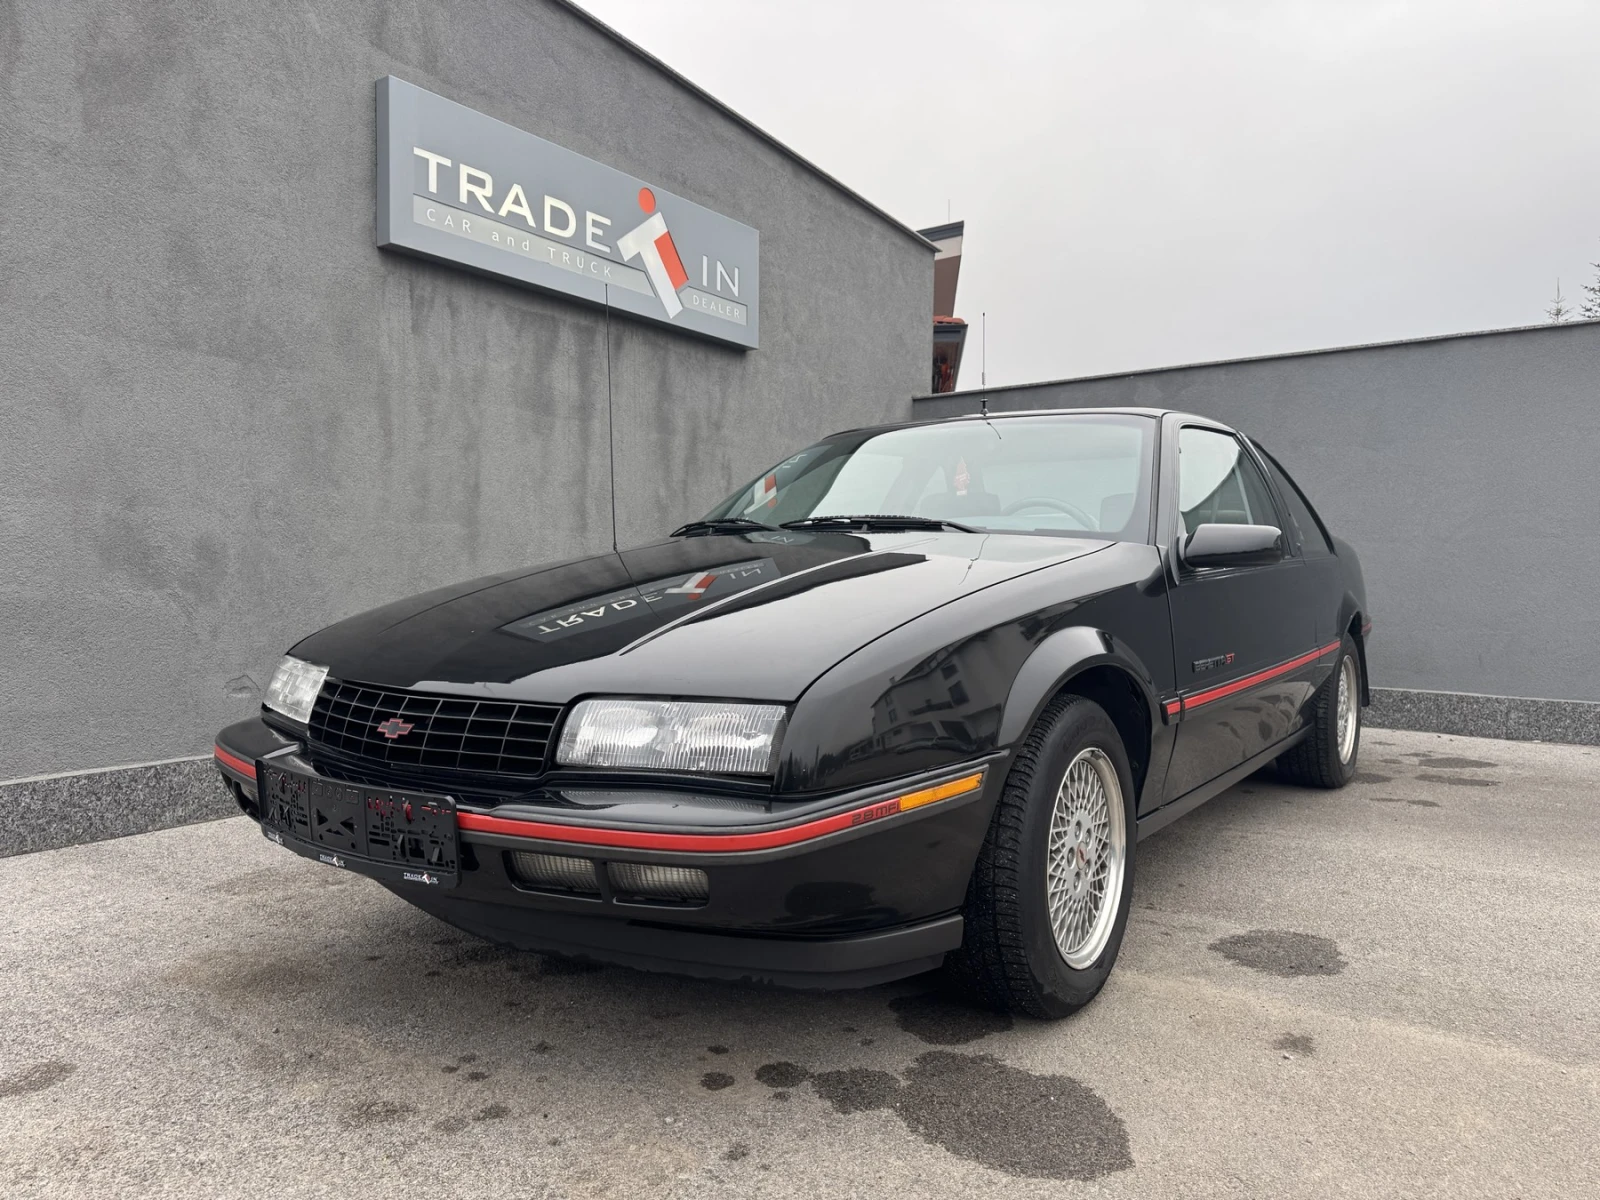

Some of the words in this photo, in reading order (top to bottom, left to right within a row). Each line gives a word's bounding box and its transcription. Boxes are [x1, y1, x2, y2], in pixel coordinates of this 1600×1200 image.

[413, 146, 612, 254] TRADE
[702, 255, 739, 297] IN
[426, 208, 472, 234] CAR
[491, 231, 530, 251] and
[547, 246, 612, 278] TRUCK
[693, 294, 740, 319] DEALER
